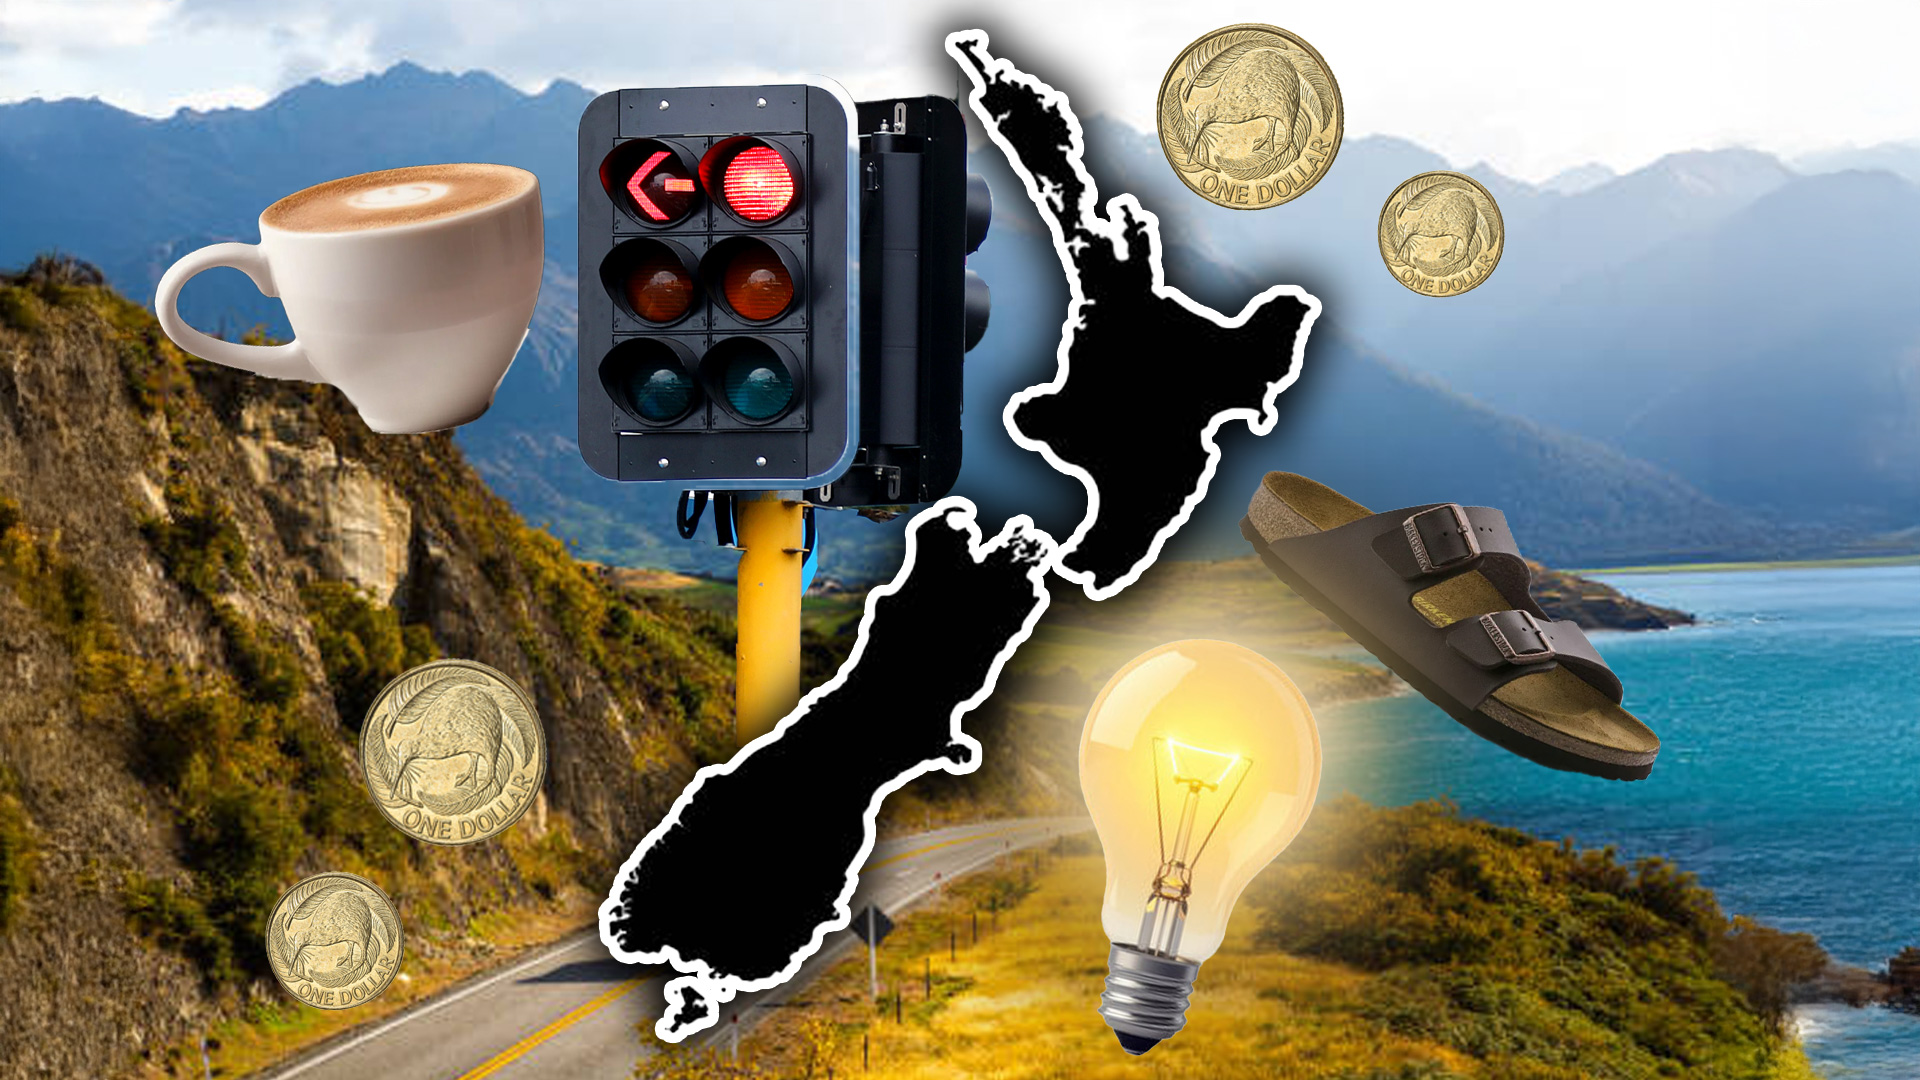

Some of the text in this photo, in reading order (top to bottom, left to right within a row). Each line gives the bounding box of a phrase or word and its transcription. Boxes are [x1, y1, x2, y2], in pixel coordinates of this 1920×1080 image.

[1199, 137, 1332, 204] ONE DOLLAR
[1401, 254, 1494, 293] ONE DOLLAR
[402, 772, 533, 839] ONE DOLLAR
[298, 956, 395, 1006] ONE DOLLAR
